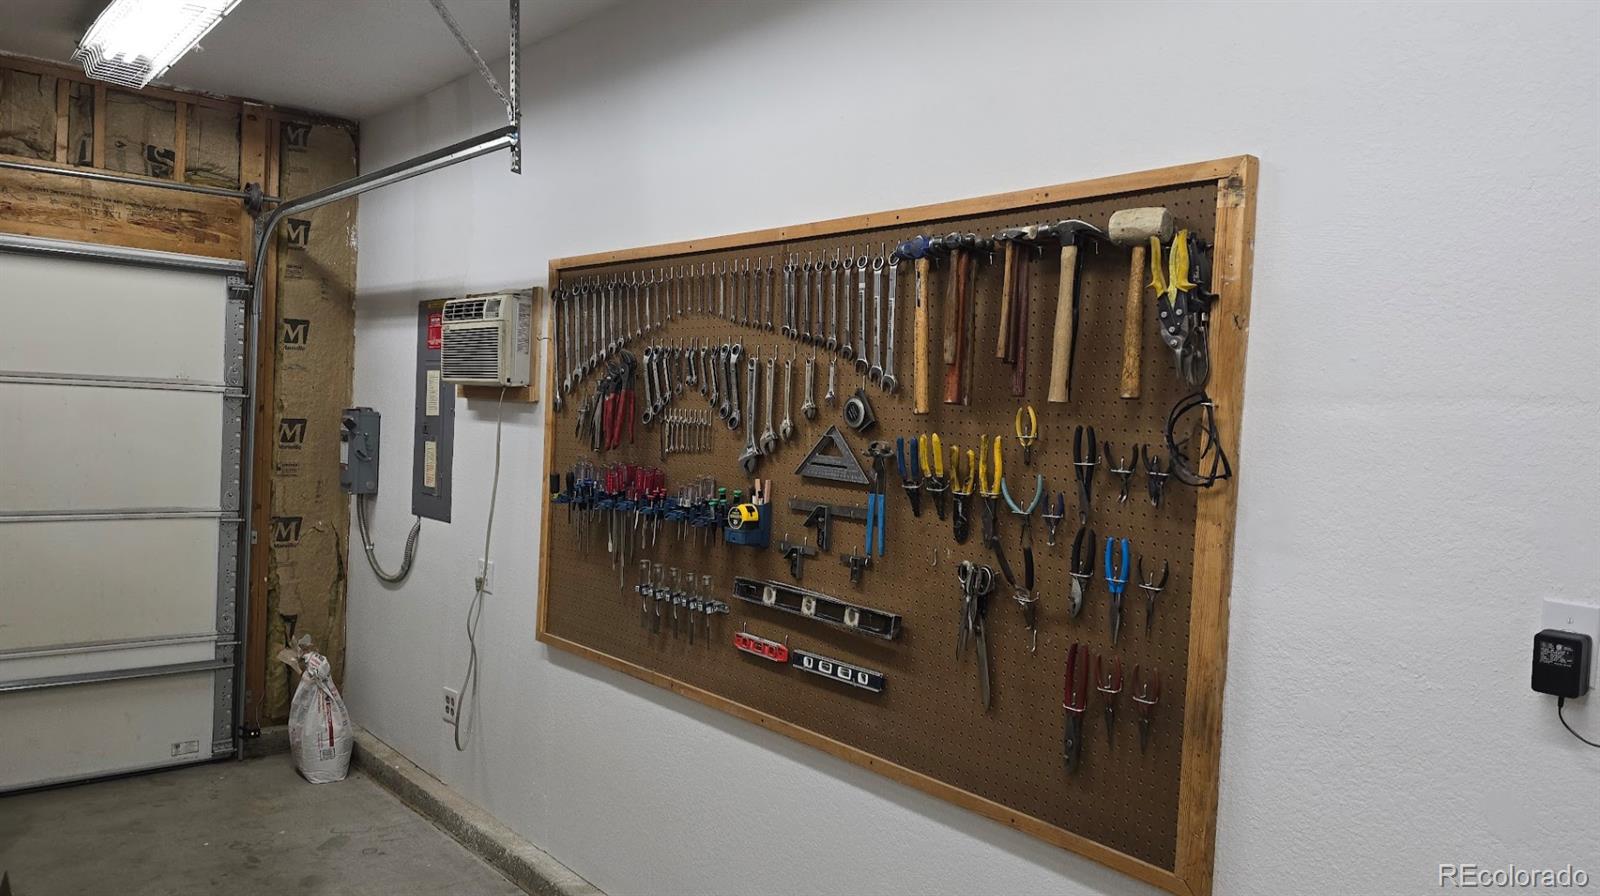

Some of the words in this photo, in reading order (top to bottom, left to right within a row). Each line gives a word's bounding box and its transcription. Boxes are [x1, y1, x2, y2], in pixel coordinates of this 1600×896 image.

[283, 321, 309, 345] M
[280, 420, 306, 445] M
[274, 518, 301, 543] M
